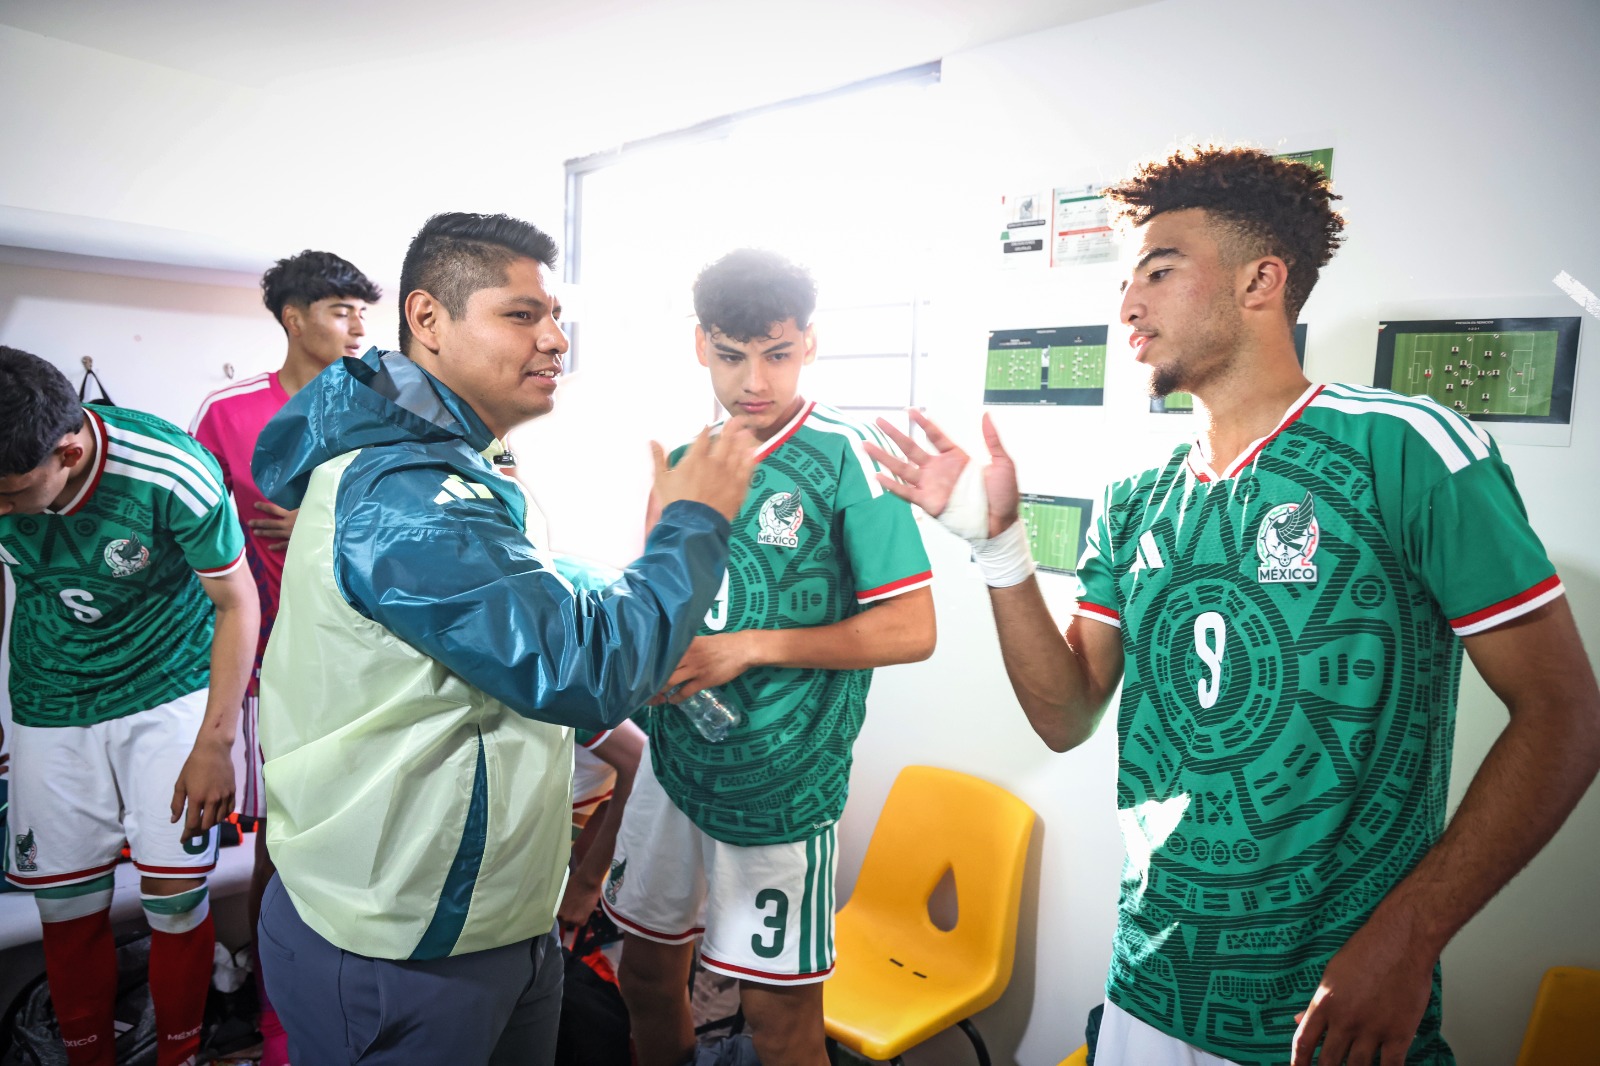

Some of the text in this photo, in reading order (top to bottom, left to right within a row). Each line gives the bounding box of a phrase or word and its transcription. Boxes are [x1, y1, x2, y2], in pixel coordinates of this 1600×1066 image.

[758, 534, 797, 546] MÉXICO
[1259, 566, 1315, 581] MÉXICO
[751, 888, 789, 959] 3
